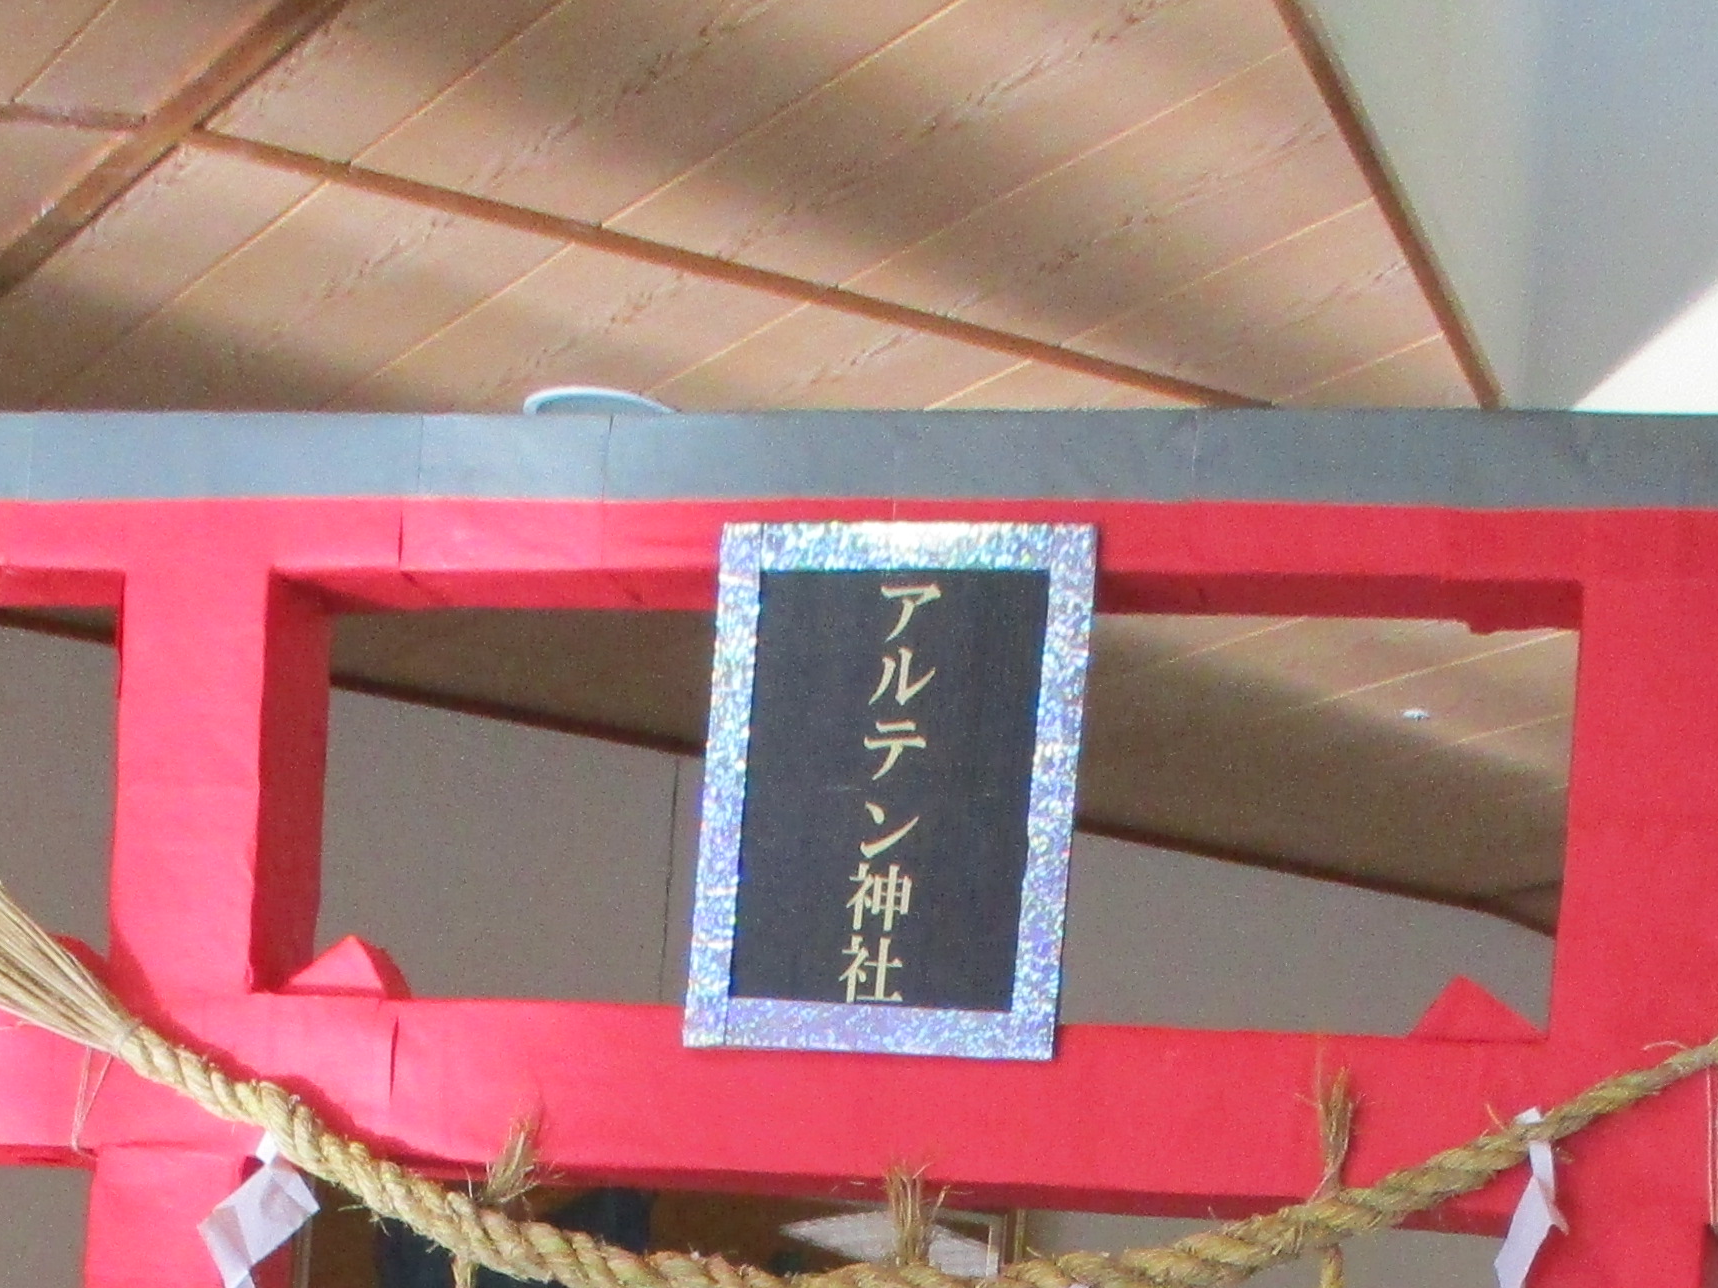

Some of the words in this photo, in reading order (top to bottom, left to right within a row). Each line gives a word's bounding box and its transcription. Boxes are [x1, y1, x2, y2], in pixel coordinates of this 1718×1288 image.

[839, 582, 942, 1004] アルテン神社
